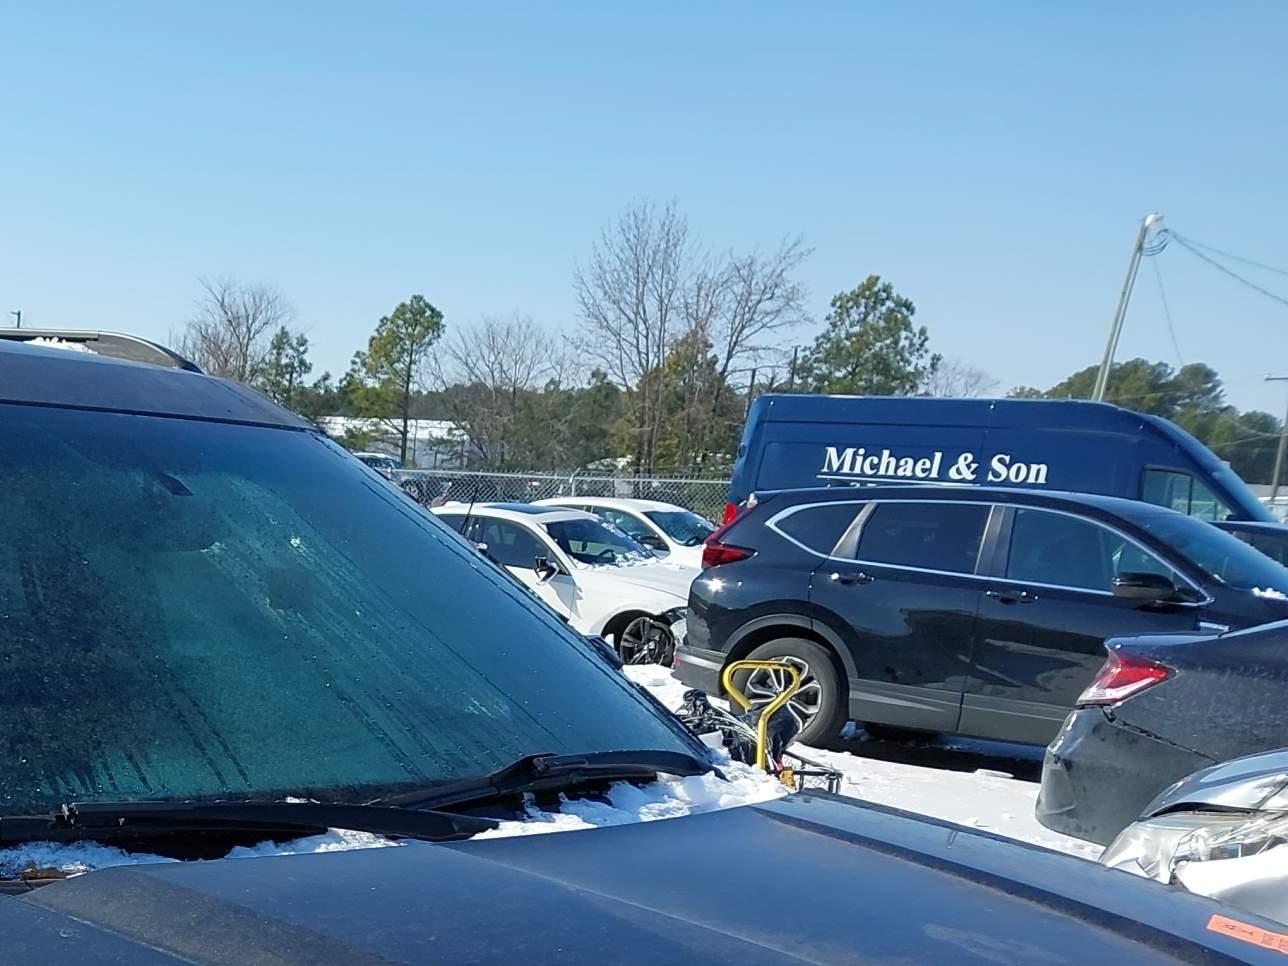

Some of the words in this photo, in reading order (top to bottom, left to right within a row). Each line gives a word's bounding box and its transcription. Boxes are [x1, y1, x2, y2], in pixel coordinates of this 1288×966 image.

[820, 446, 943, 478] Michael
[948, 452, 979, 481] &
[987, 454, 1048, 484] Son
